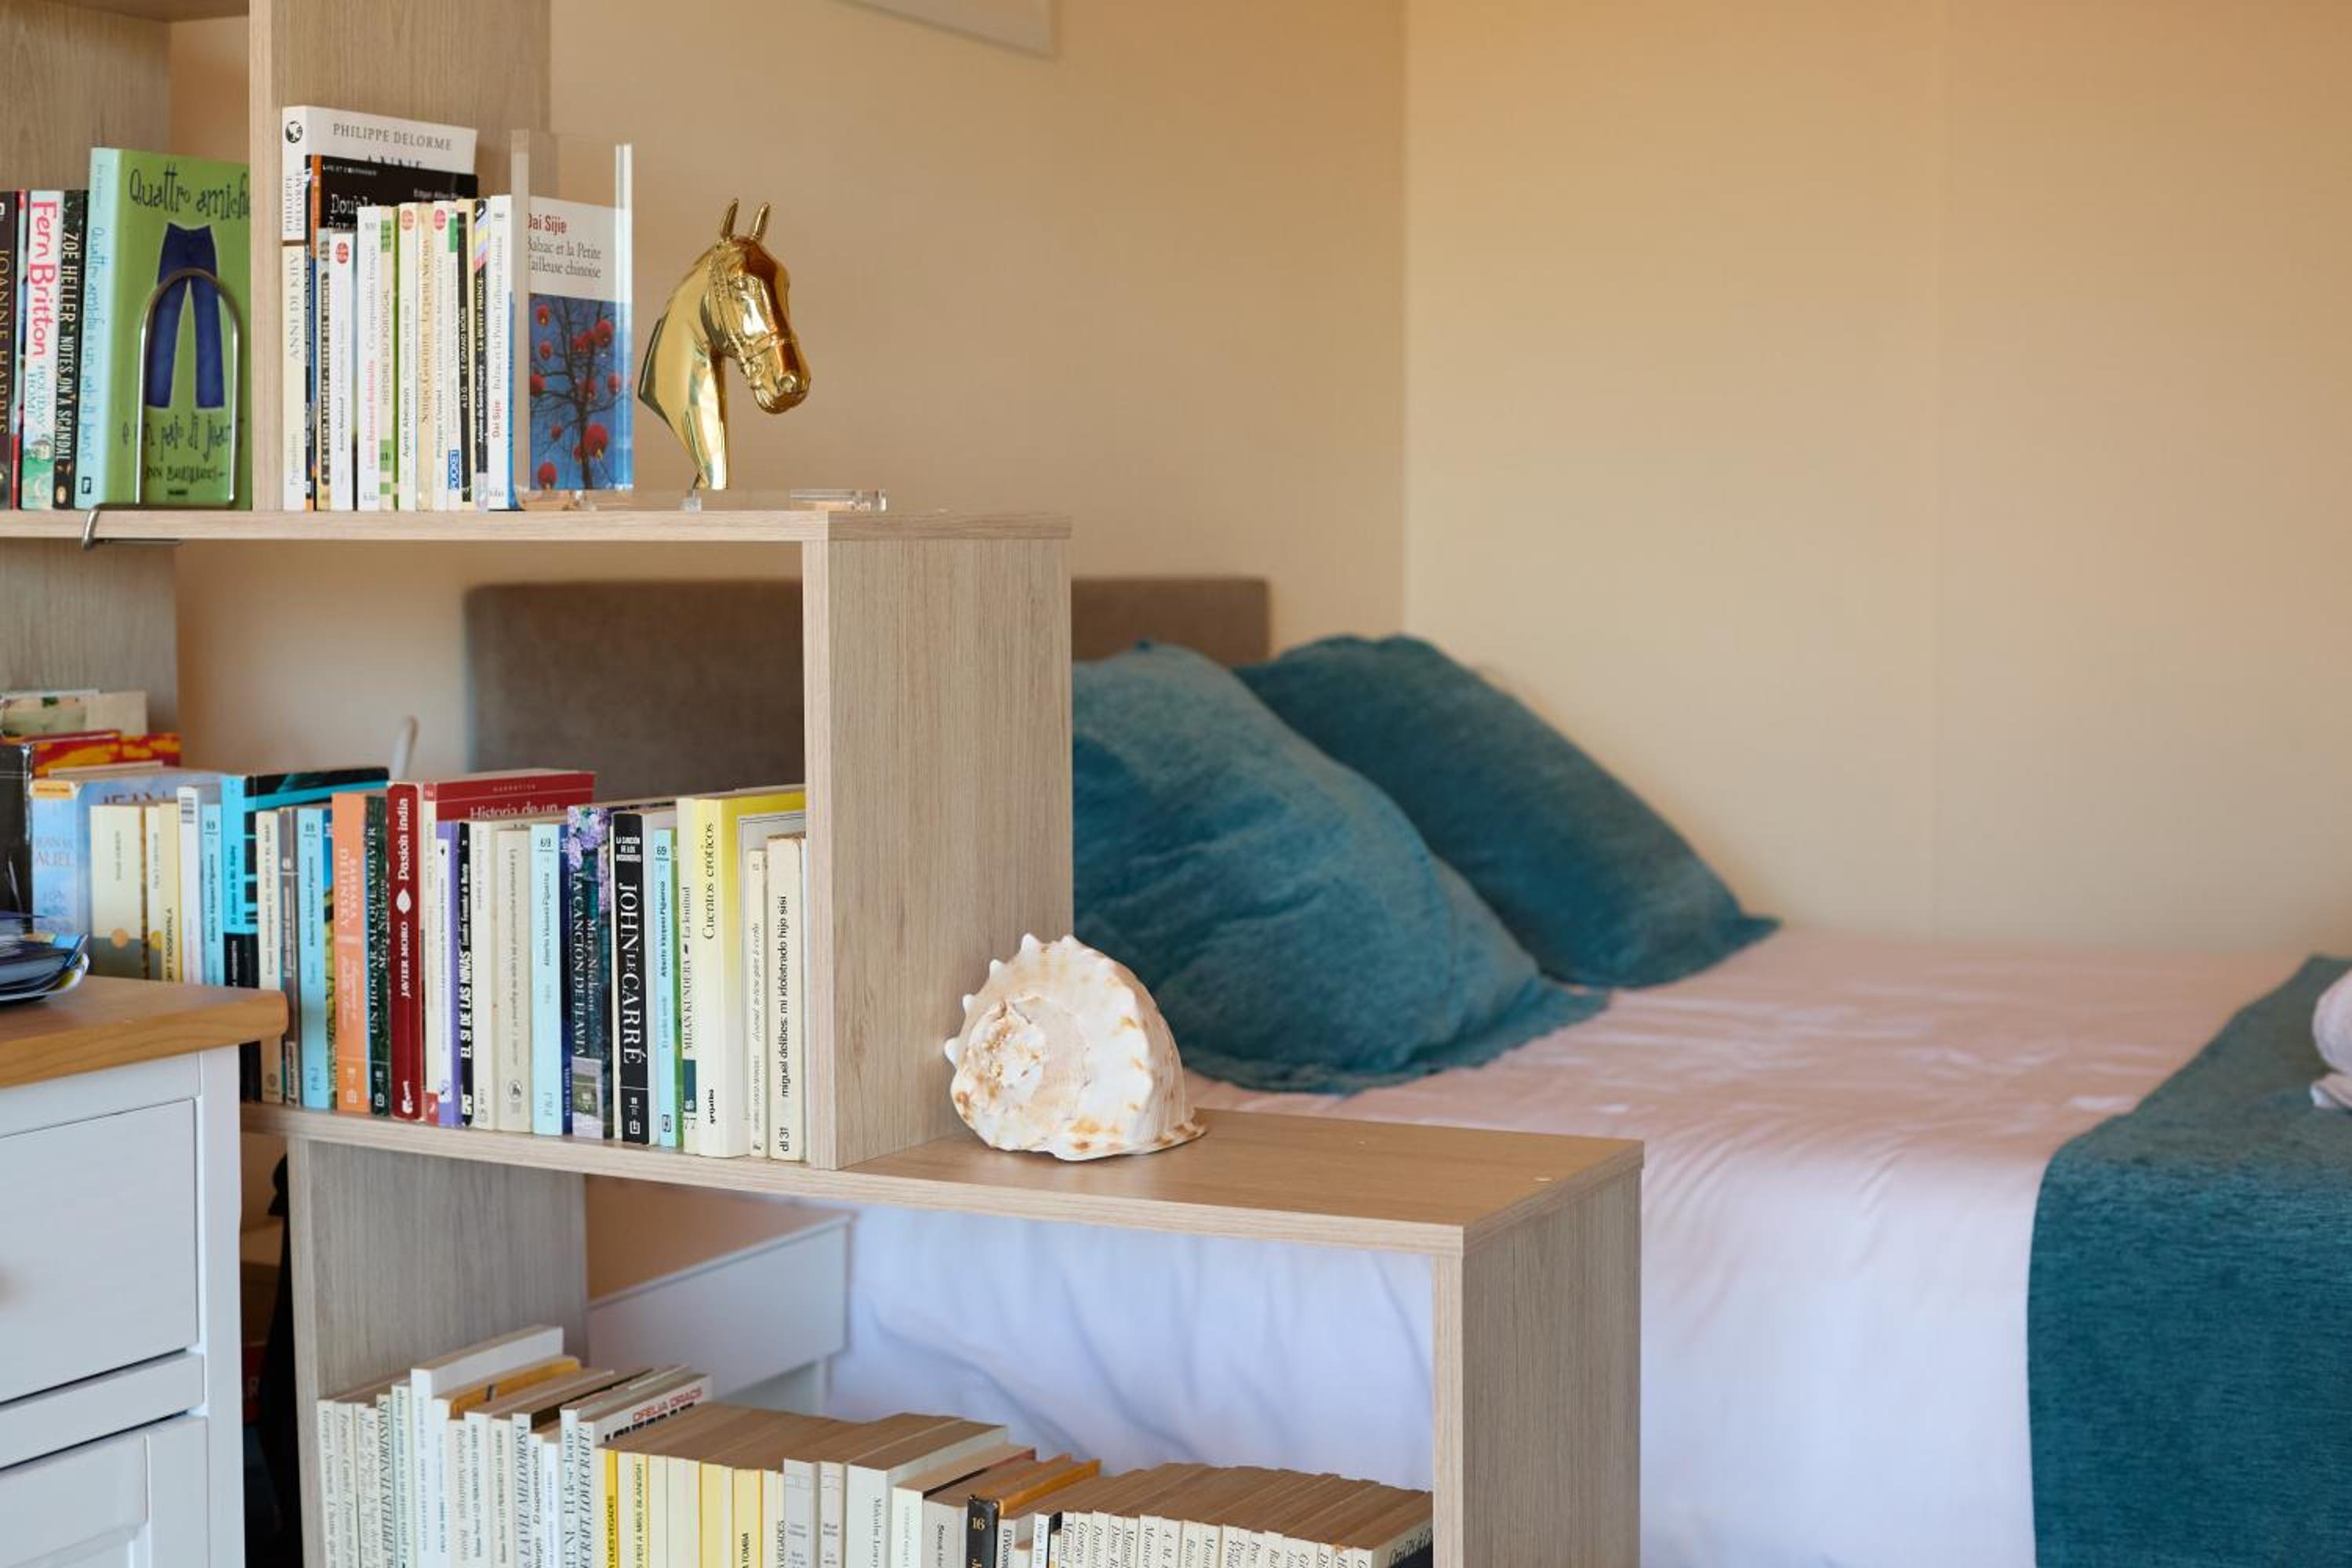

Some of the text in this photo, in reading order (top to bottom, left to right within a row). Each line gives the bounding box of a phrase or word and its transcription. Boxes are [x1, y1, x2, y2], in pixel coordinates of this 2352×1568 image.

[333, 122, 452, 151] PHILIPPE DELORME
[130, 162, 191, 213] Quattro
[197, 172, 250, 220] amich
[330, 194, 376, 216] Doubl
[545, 214, 567, 236] Sijie
[29, 200, 57, 356] Fern Britton
[60, 265, 78, 322] HELLER
[381, 288, 390, 338] PORTUGAL
[59, 336, 75, 373] NOTES
[58, 376, 74, 392] ON
[55, 409, 71, 461] SCANDAL
[449, 452, 459, 489] POCKET
[397, 798, 408, 832] india
[470, 801, 557, 818] Historia de un
[338, 847, 350, 929] DELINSKY
[702, 884, 715, 940] Cuentos
[776, 917, 789, 938] hijo
[400, 921, 408, 957] MORO
[369, 949, 379, 1007] HOGAR
[401, 960, 410, 997] JAVIER
[573, 872, 589, 1055] LA CANCIÓN DE FLAVIA
[585, 918, 598, 1011] Mary Nickson
[618, 882, 646, 1064] JOHN LE CARRÉ
[659, 950, 667, 978] Alberto
[681, 887, 692, 1051] MILAN KUNDERA La lentitud
[777, 941, 789, 997] idolatrado
[460, 986, 472, 1009] LAS
[777, 1000, 788, 1014] mi
[460, 1011, 471, 1026] DE
[460, 1045, 471, 1059] EL
[777, 1017, 789, 1059] delibes:
[779, 1061, 790, 1098] miguel
[579, 1428, 592, 1513] LOVECRAFT!
[518, 1510, 530, 1535] VEU
[1110, 1525, 1121, 1554] Dino
[519, 1538, 532, 1556] LA
[741, 1532, 750, 1562] TOMBA
[1075, 1522, 1089, 1565] Georges
[1250, 1541, 1261, 1564] Pere
